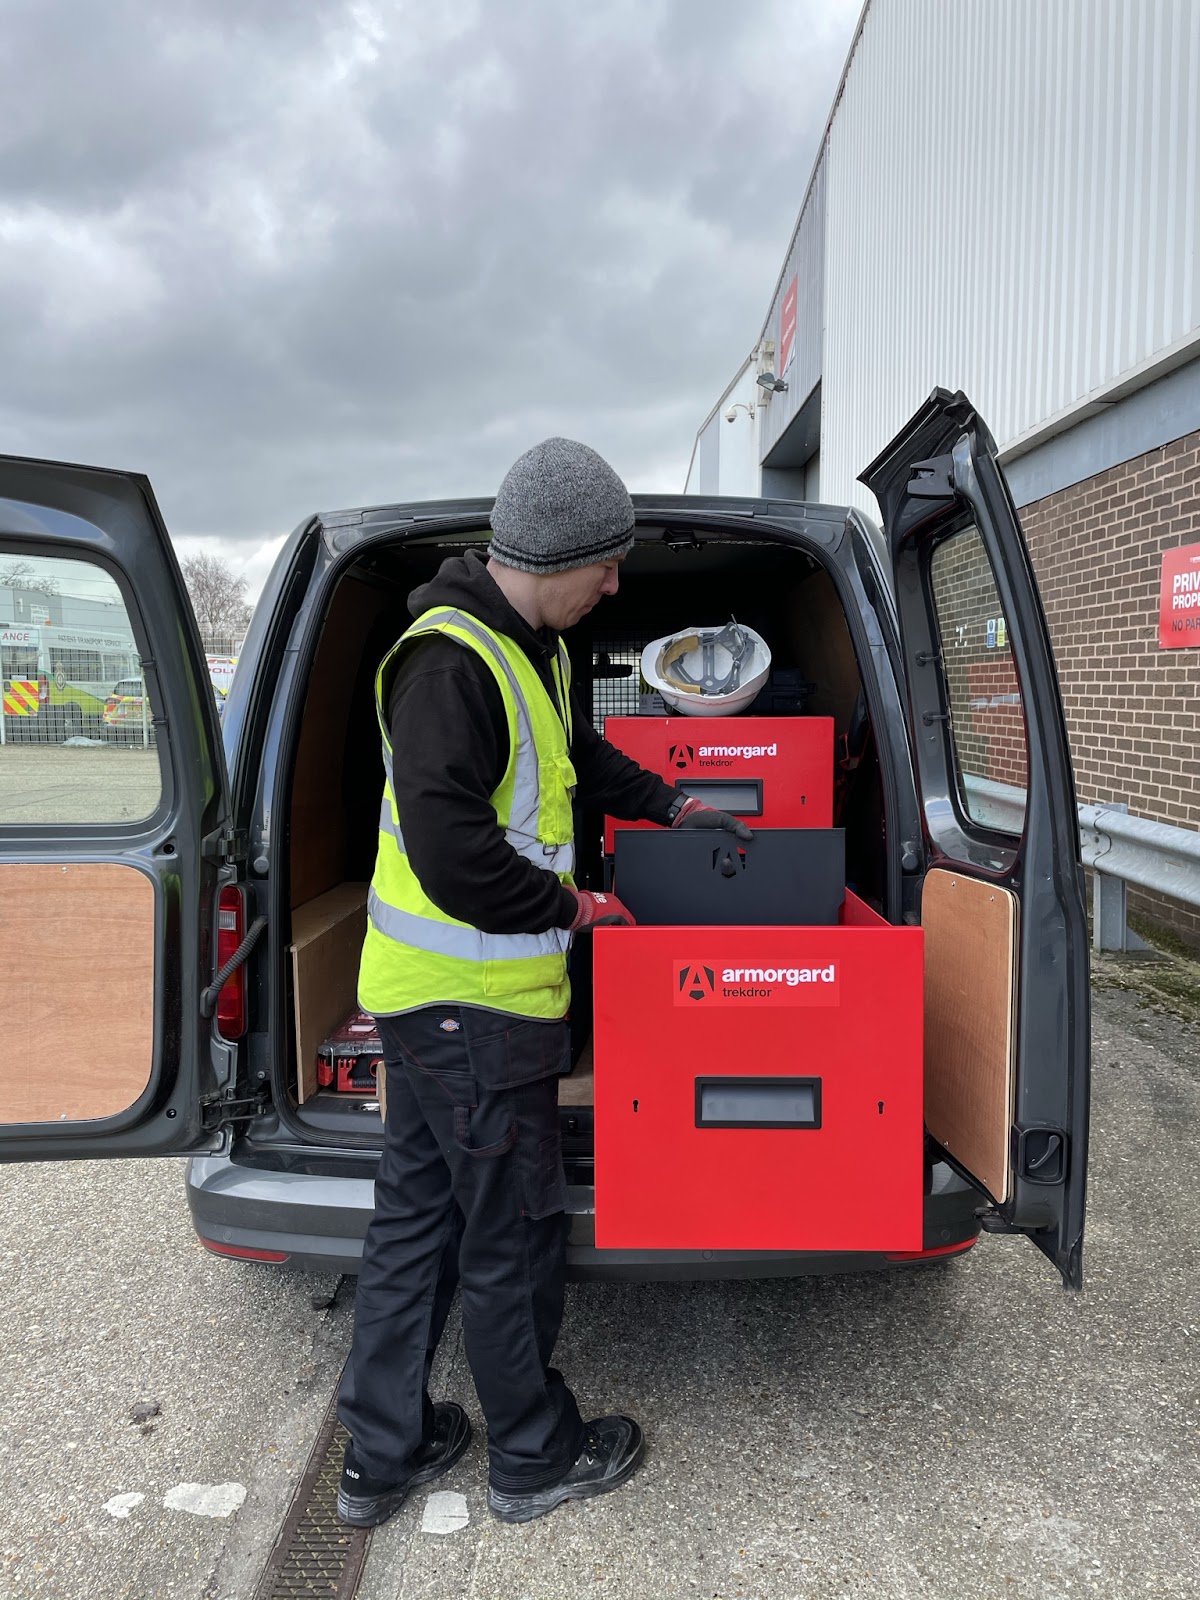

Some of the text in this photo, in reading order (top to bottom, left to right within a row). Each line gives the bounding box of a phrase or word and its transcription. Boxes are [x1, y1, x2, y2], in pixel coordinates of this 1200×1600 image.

[1172, 619, 1183, 631] NO
[2, 632, 30, 641] ANCE
[698, 743, 777, 759] armorgard
[699, 759, 733, 767] trekdror
[721, 964, 835, 986] armorgard
[722, 987, 772, 997] trekdror
